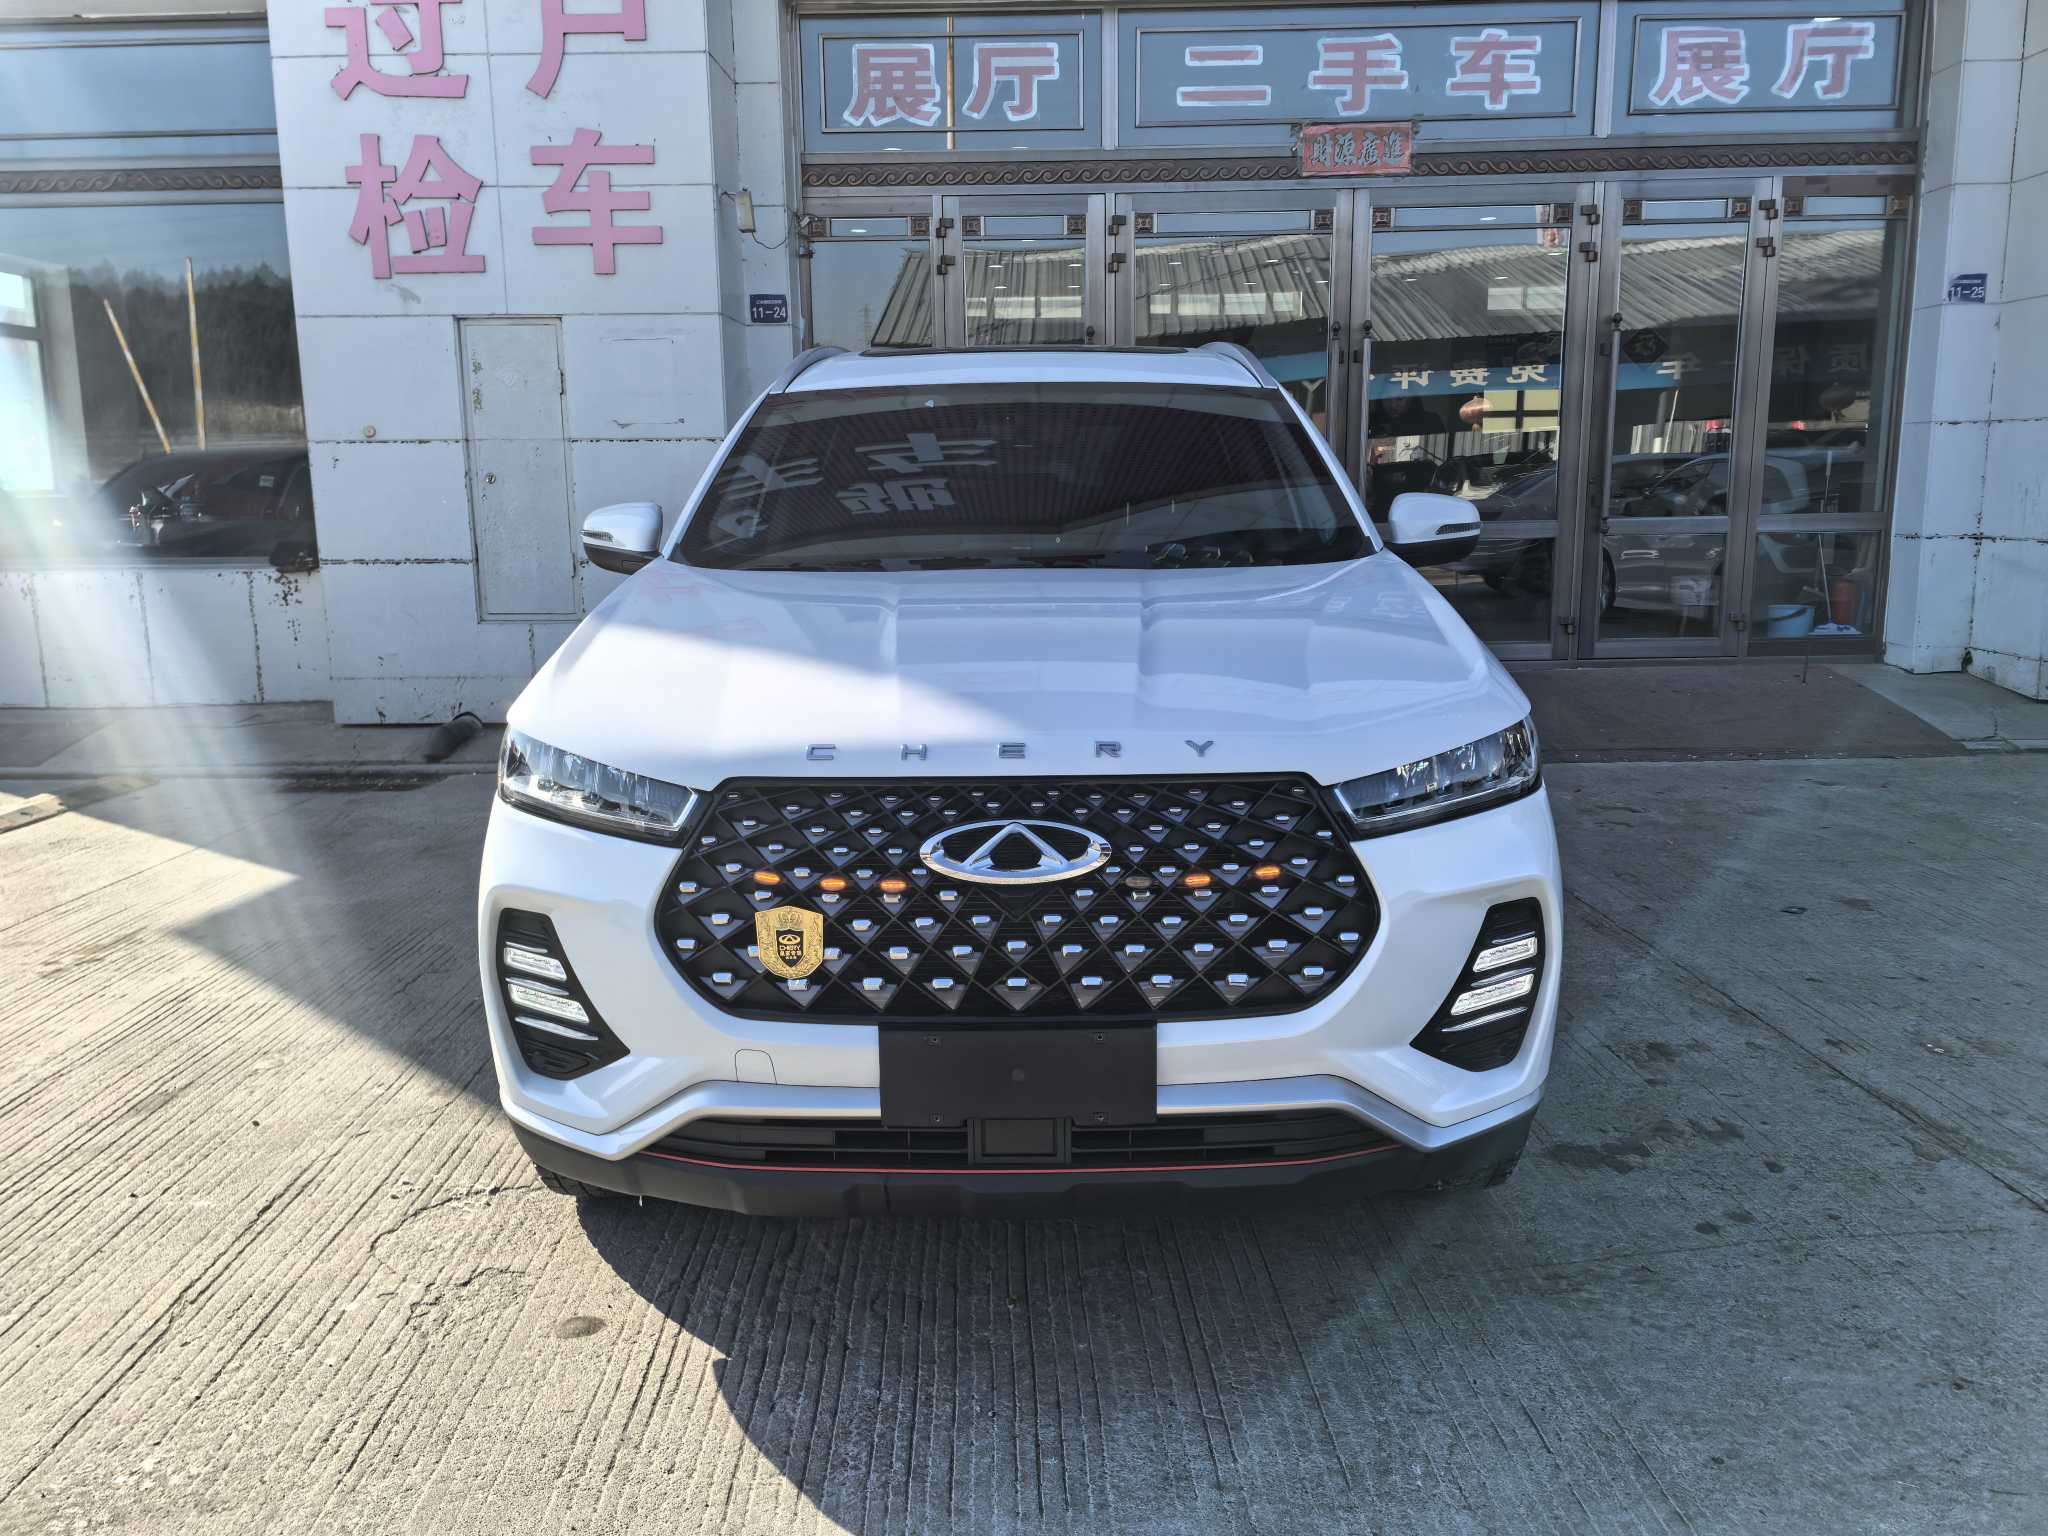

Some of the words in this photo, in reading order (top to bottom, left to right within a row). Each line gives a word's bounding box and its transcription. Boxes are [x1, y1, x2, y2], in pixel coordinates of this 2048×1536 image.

[842, 42, 1060, 127] 展厅
[1176, 28, 1542, 117] 二手车
[1649, 21, 1875, 107] 展厅
[345, 128, 664, 279] 检车
[752, 307, 786, 319] 11-24
[1950, 286, 1984, 298] 11-25
[806, 740, 1214, 761] CHERY
